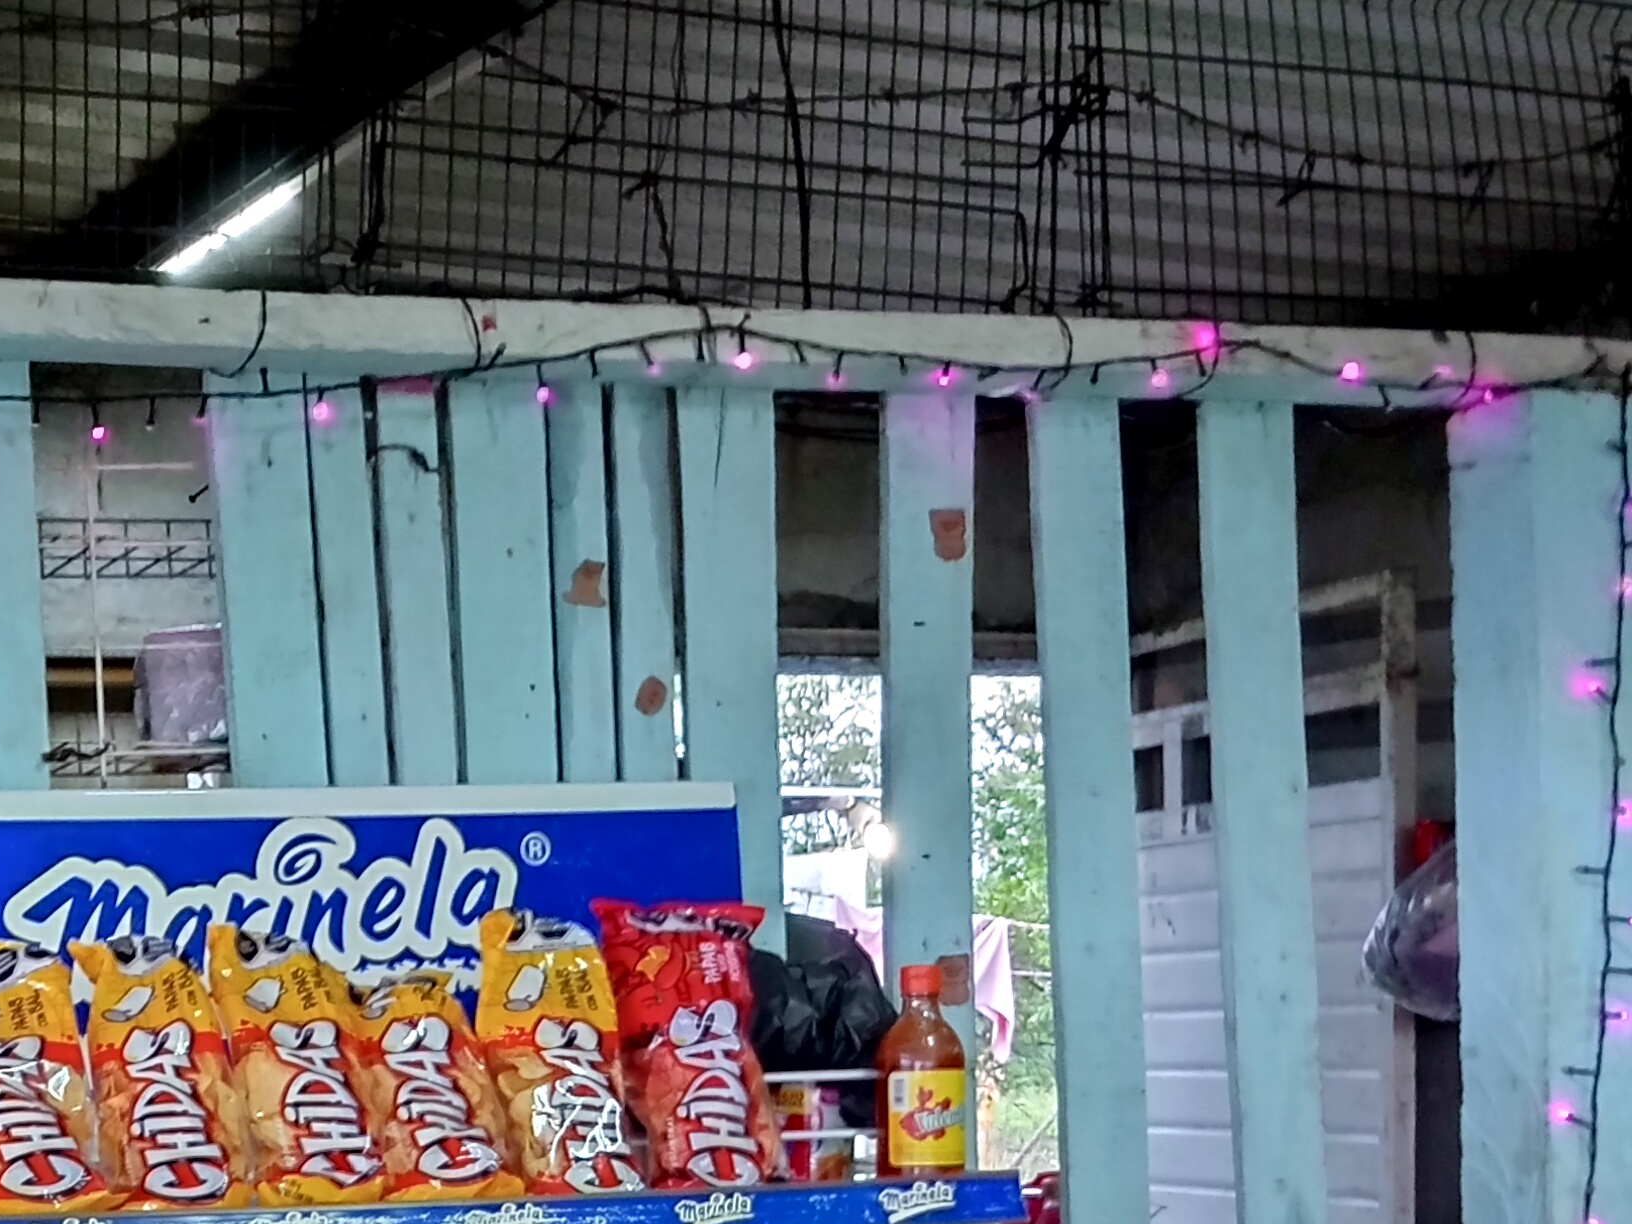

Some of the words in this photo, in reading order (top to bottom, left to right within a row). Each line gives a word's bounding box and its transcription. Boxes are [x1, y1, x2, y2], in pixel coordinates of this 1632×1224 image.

[13, 824, 508, 974] Marinela
[675, 1192, 753, 1223] Marinela
[879, 1181, 954, 1211] Marinela
